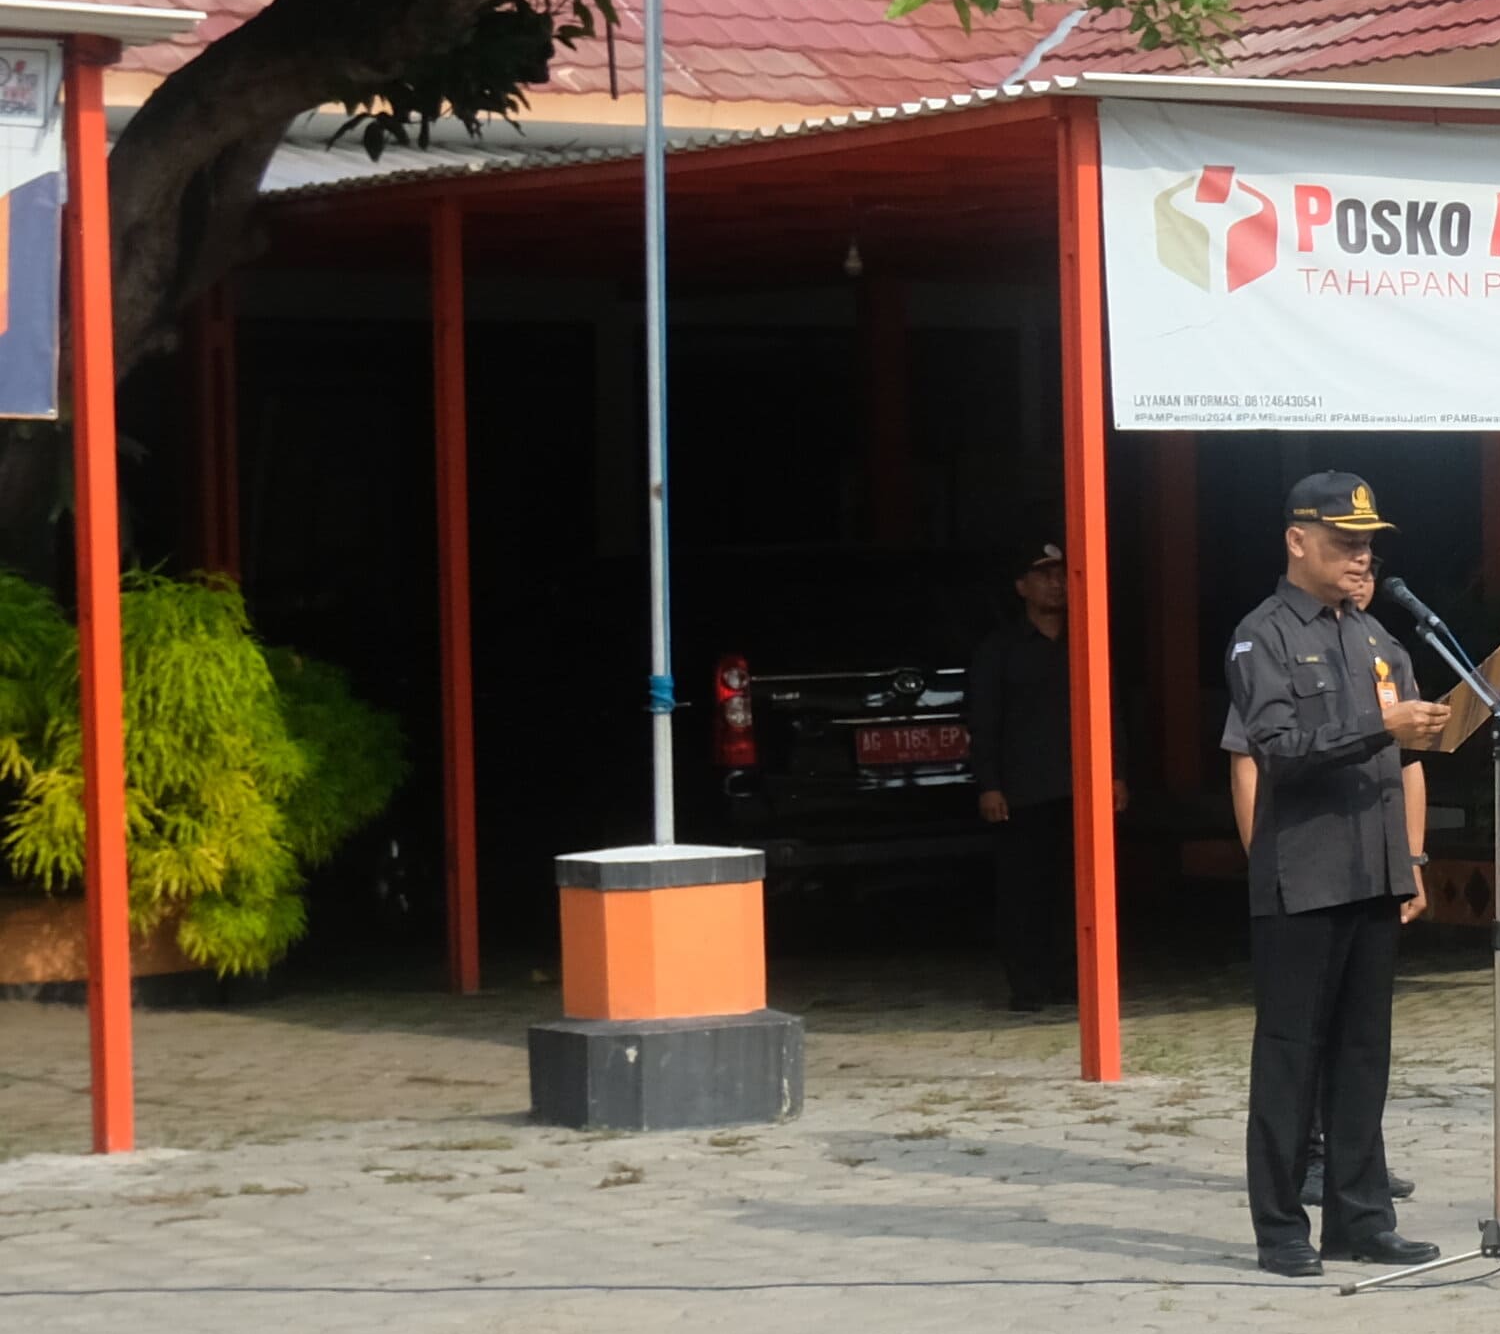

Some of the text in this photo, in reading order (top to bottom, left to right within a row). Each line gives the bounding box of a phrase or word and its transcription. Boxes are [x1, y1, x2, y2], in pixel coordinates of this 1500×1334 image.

[1294, 184, 1472, 256] POSKO
[1297, 268, 1470, 297] TAHAPAN
[1133, 394, 1181, 407] LAYANAN
[940, 728, 960, 748] EP
